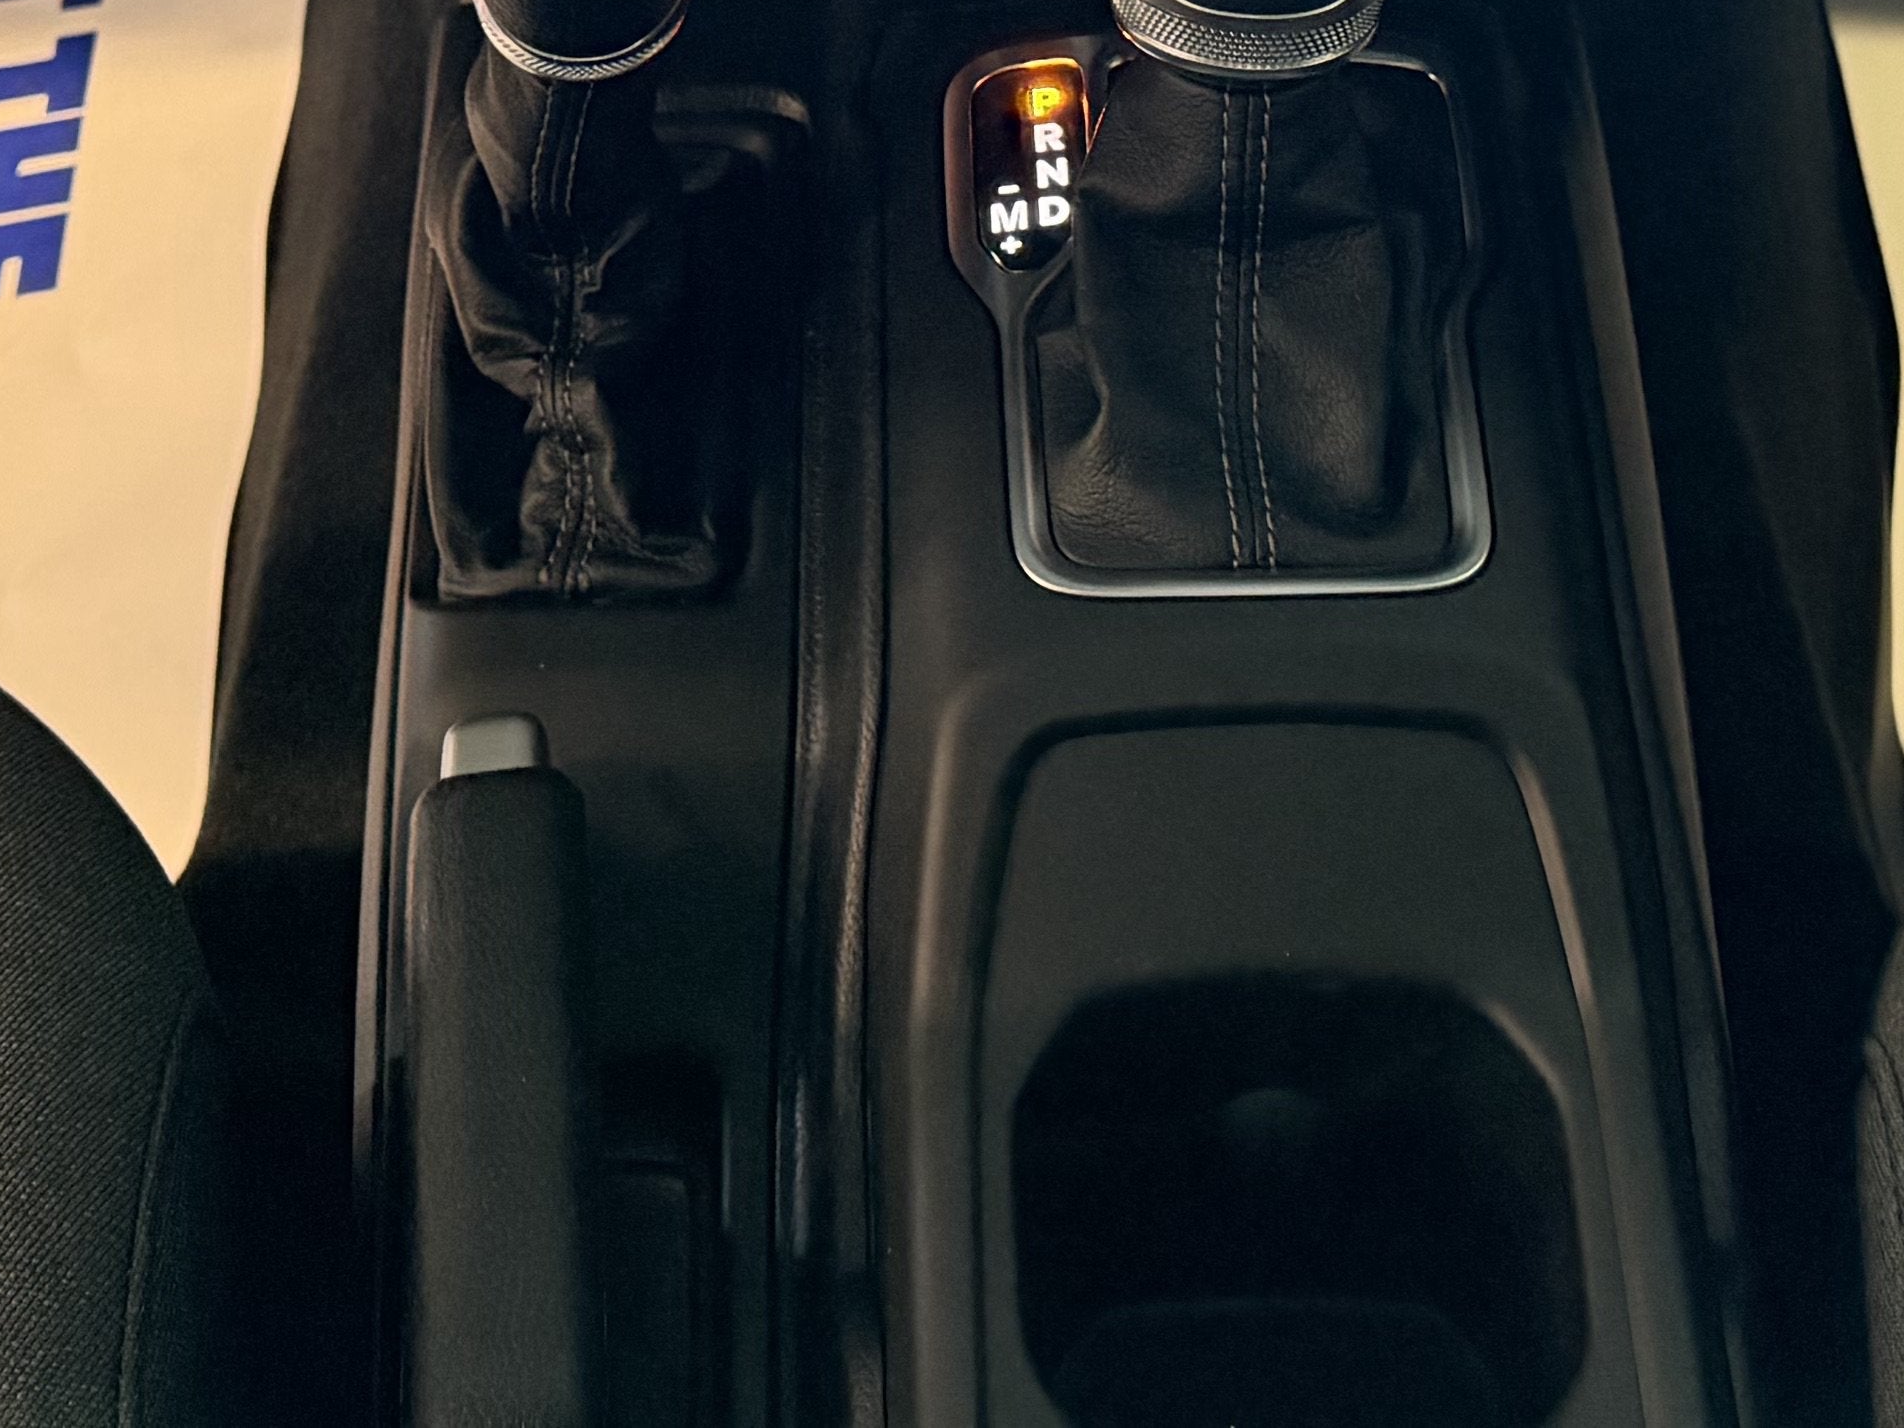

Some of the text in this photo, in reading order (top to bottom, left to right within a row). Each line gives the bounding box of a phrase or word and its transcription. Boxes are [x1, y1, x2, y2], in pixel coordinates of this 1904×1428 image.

[1032, 87, 1060, 117] P
[1033, 123, 1065, 152] R
[1036, 158, 1069, 189] N
[990, 201, 1029, 233] M
[1038, 196, 1072, 227] D
